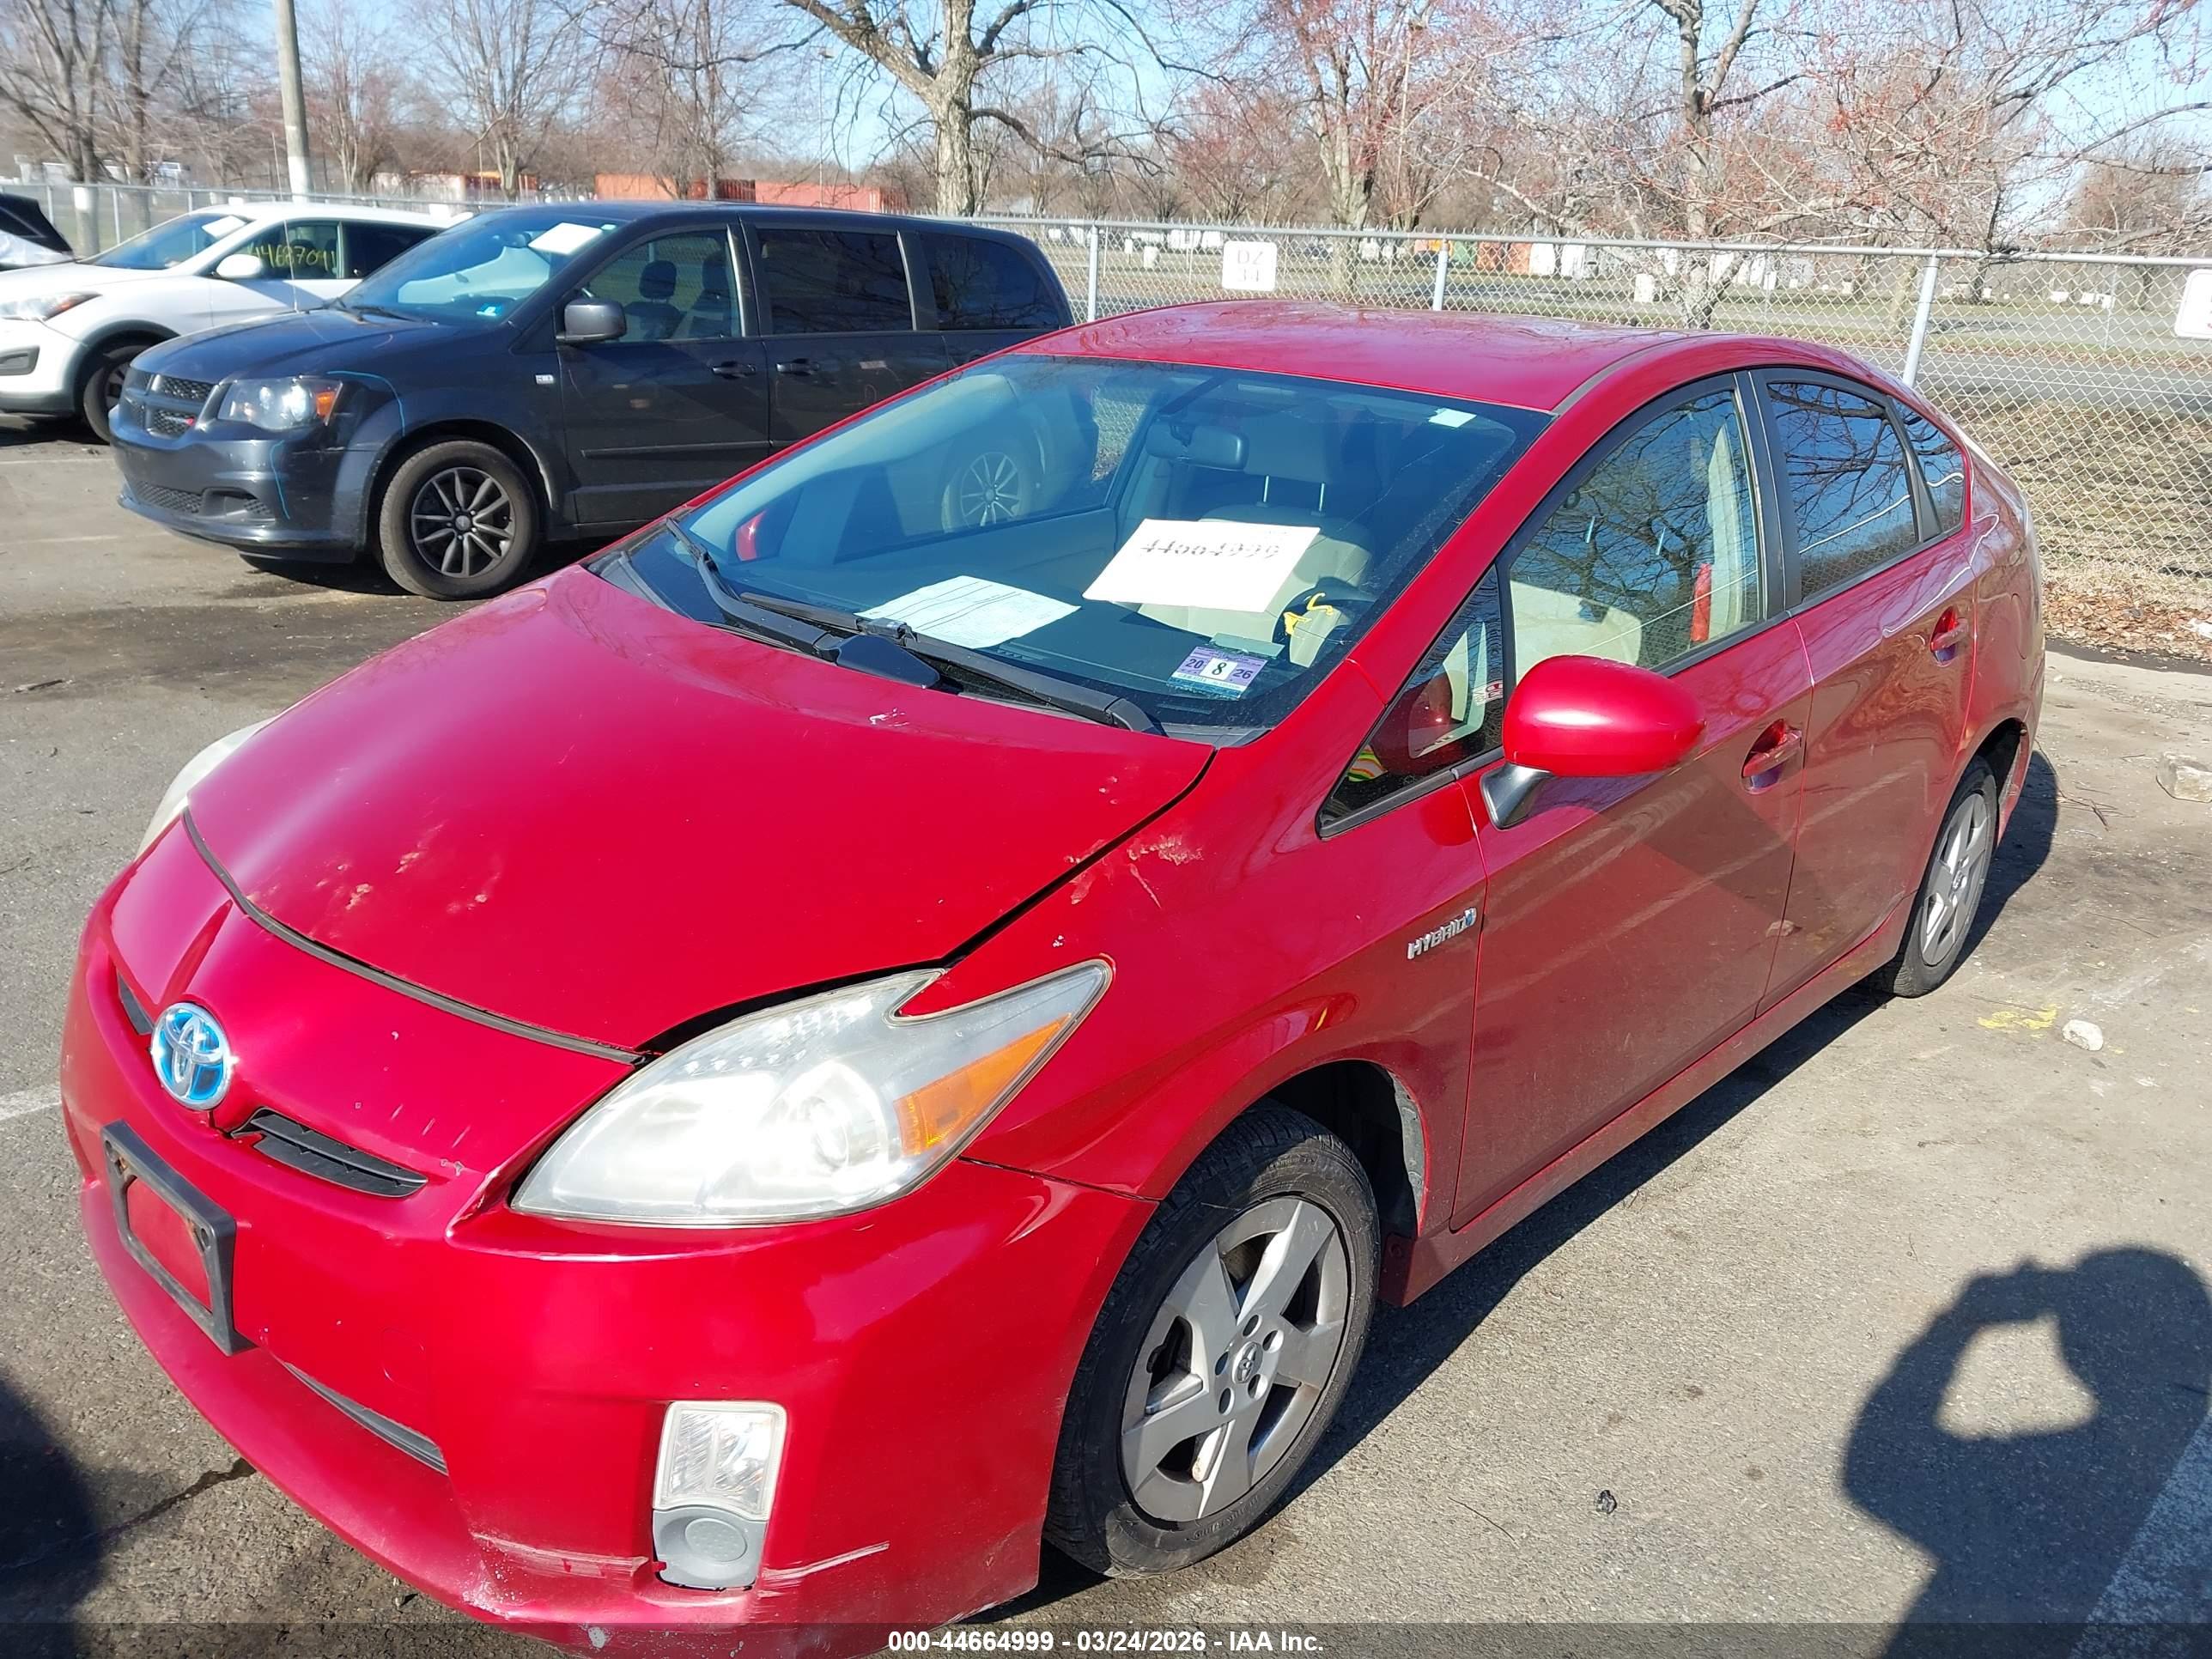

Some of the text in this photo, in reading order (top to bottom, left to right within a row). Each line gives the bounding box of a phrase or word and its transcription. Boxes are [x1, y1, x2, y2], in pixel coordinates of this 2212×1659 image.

[1185, 659, 1254, 679] 20 8 26
[1407, 913, 1468, 959] HYBRID
